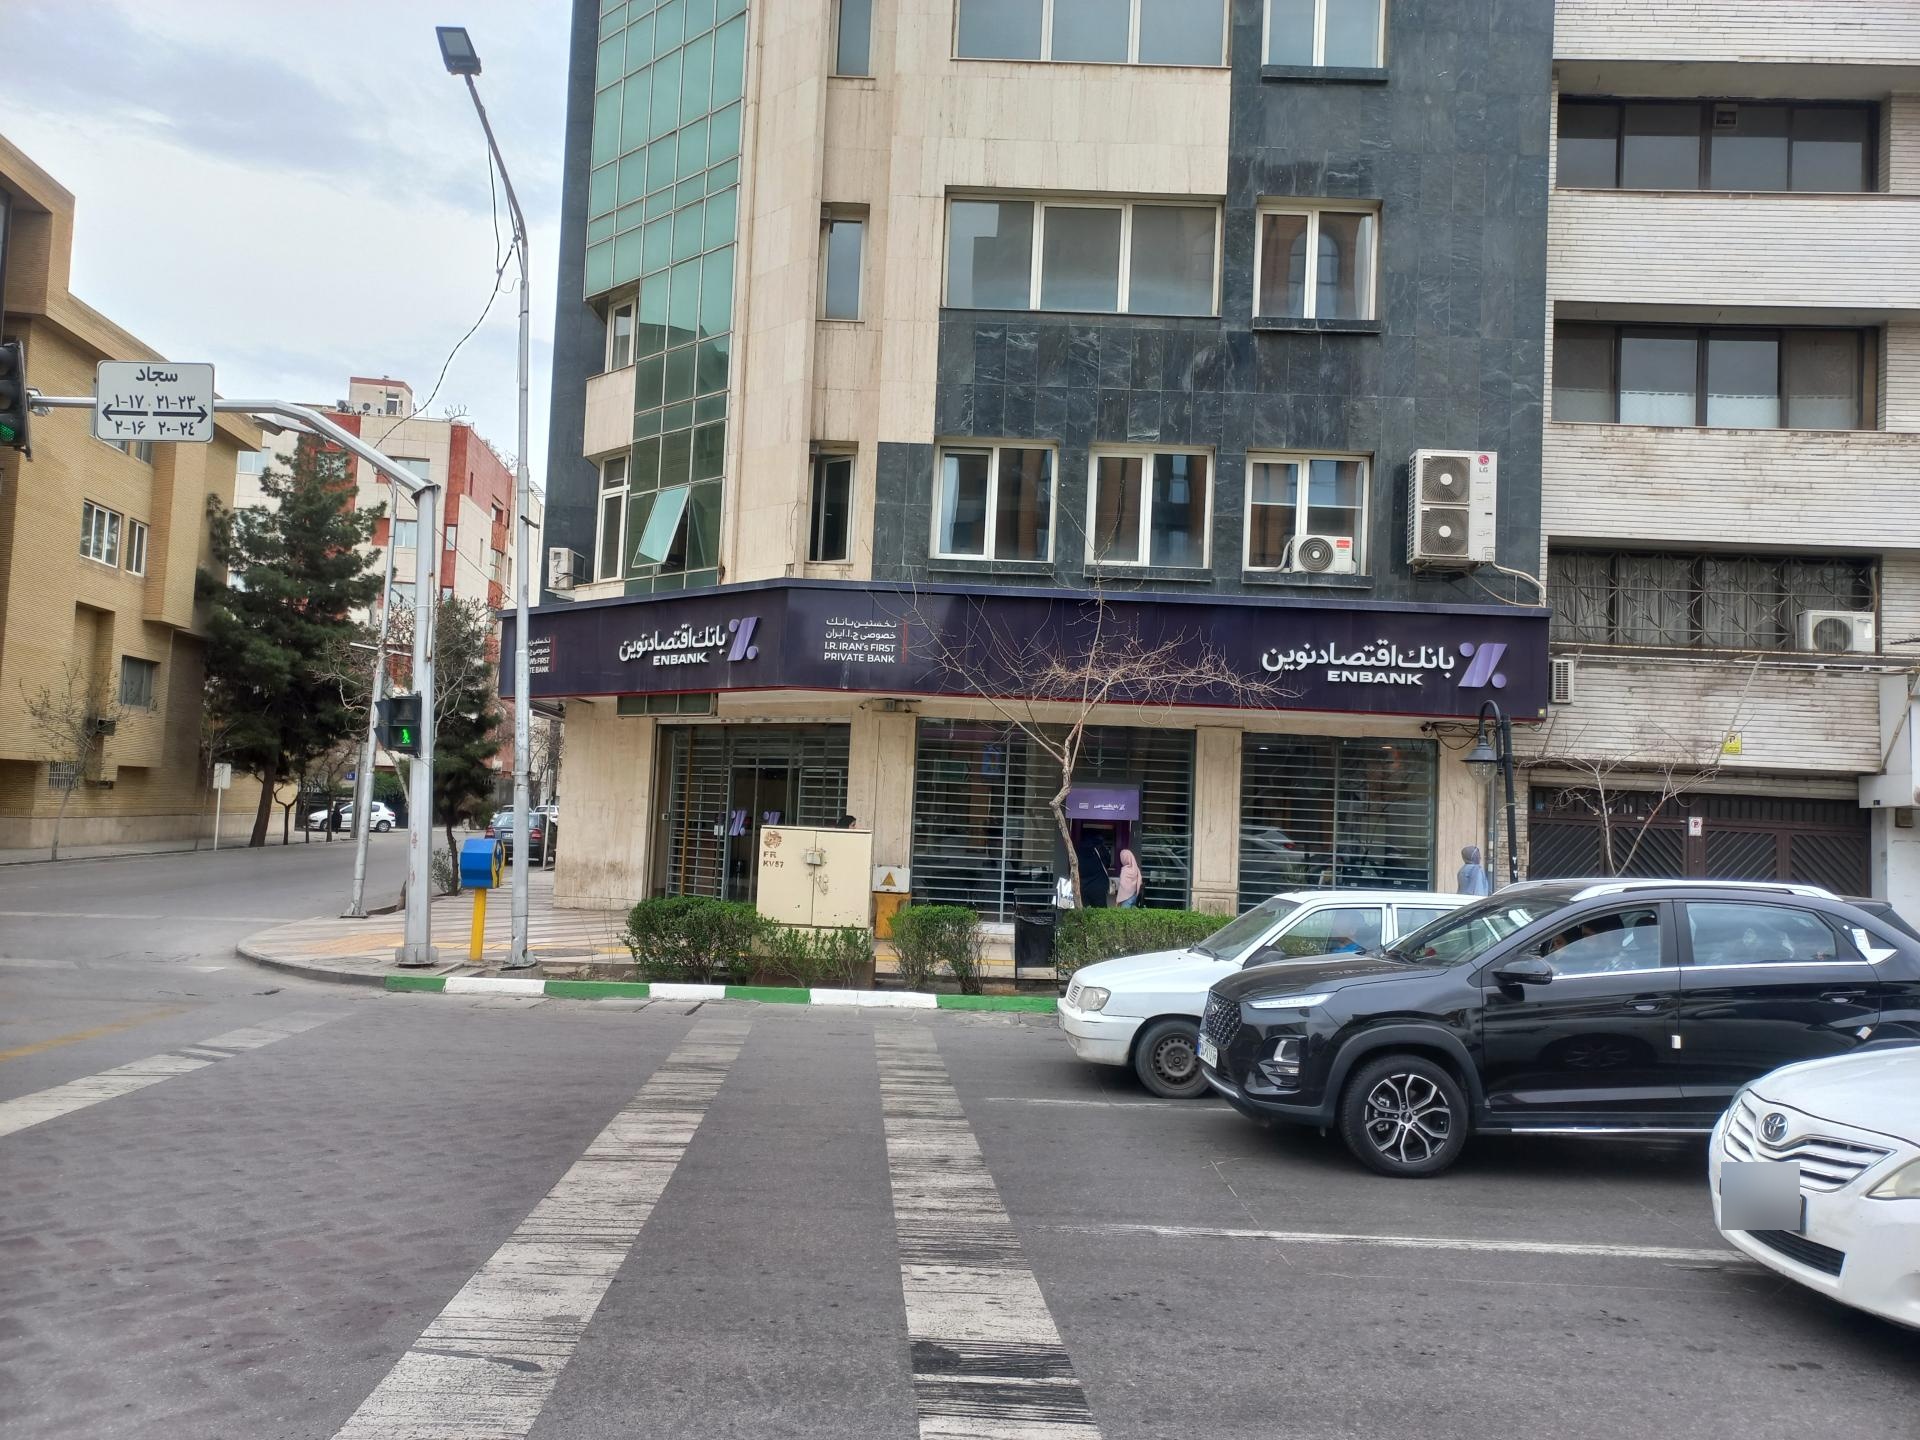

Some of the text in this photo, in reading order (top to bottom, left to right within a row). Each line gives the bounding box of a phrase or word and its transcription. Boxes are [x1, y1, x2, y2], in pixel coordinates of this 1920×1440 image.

[135, 366, 178, 387] سجاد
[870, 643, 896, 653] FIRST
[652, 651, 710, 666] ENBANK
[823, 652, 896, 664] PRIVATE BANK
[1327, 670, 1424, 686] ENBANK
